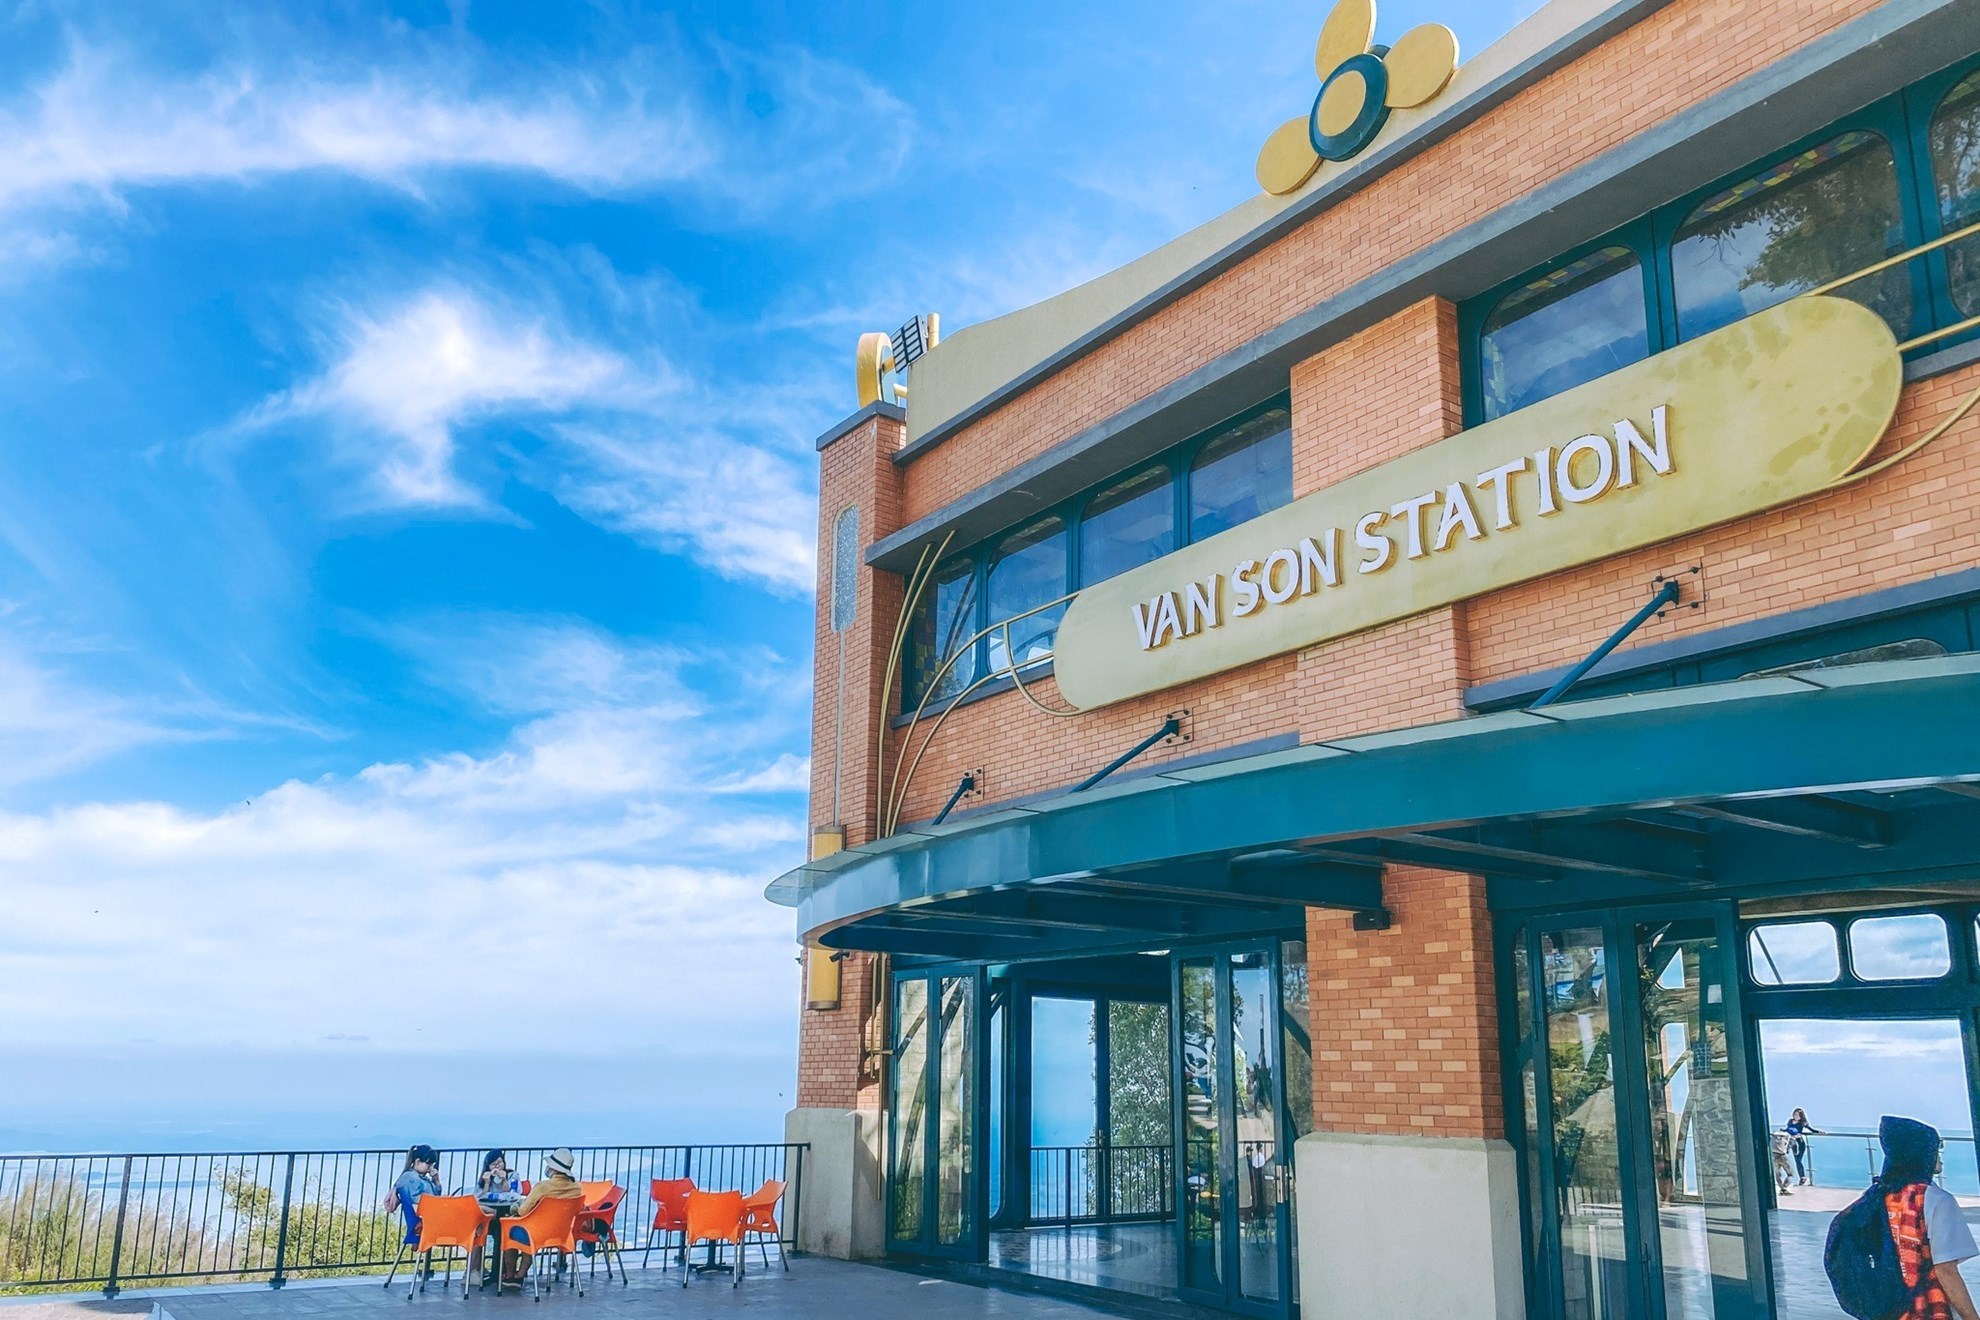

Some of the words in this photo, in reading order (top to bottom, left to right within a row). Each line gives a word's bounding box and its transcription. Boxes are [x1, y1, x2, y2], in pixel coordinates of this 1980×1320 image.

[1131, 573, 1221, 650] VAN
[1231, 527, 1342, 617] SON
[1355, 404, 1676, 573] STATION
